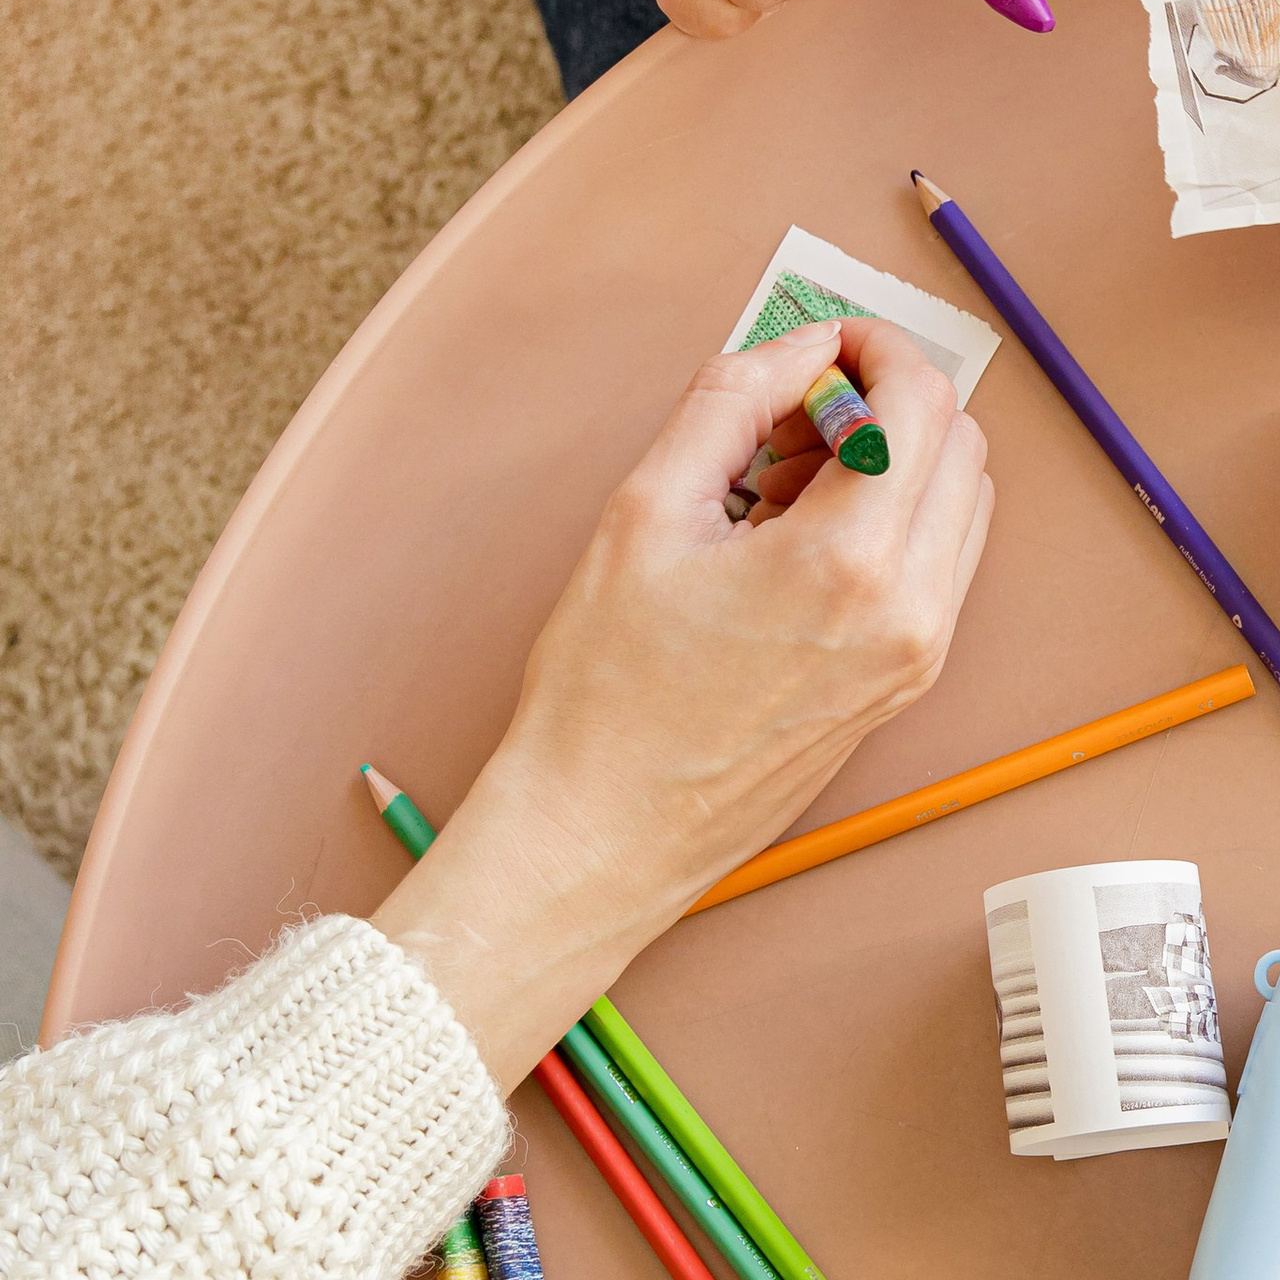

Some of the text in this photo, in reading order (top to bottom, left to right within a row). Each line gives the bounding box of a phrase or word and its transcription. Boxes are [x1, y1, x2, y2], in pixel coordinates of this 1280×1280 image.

[1134, 483, 1166, 524] MILAN
[1178, 544, 1216, 594] rubber touch
